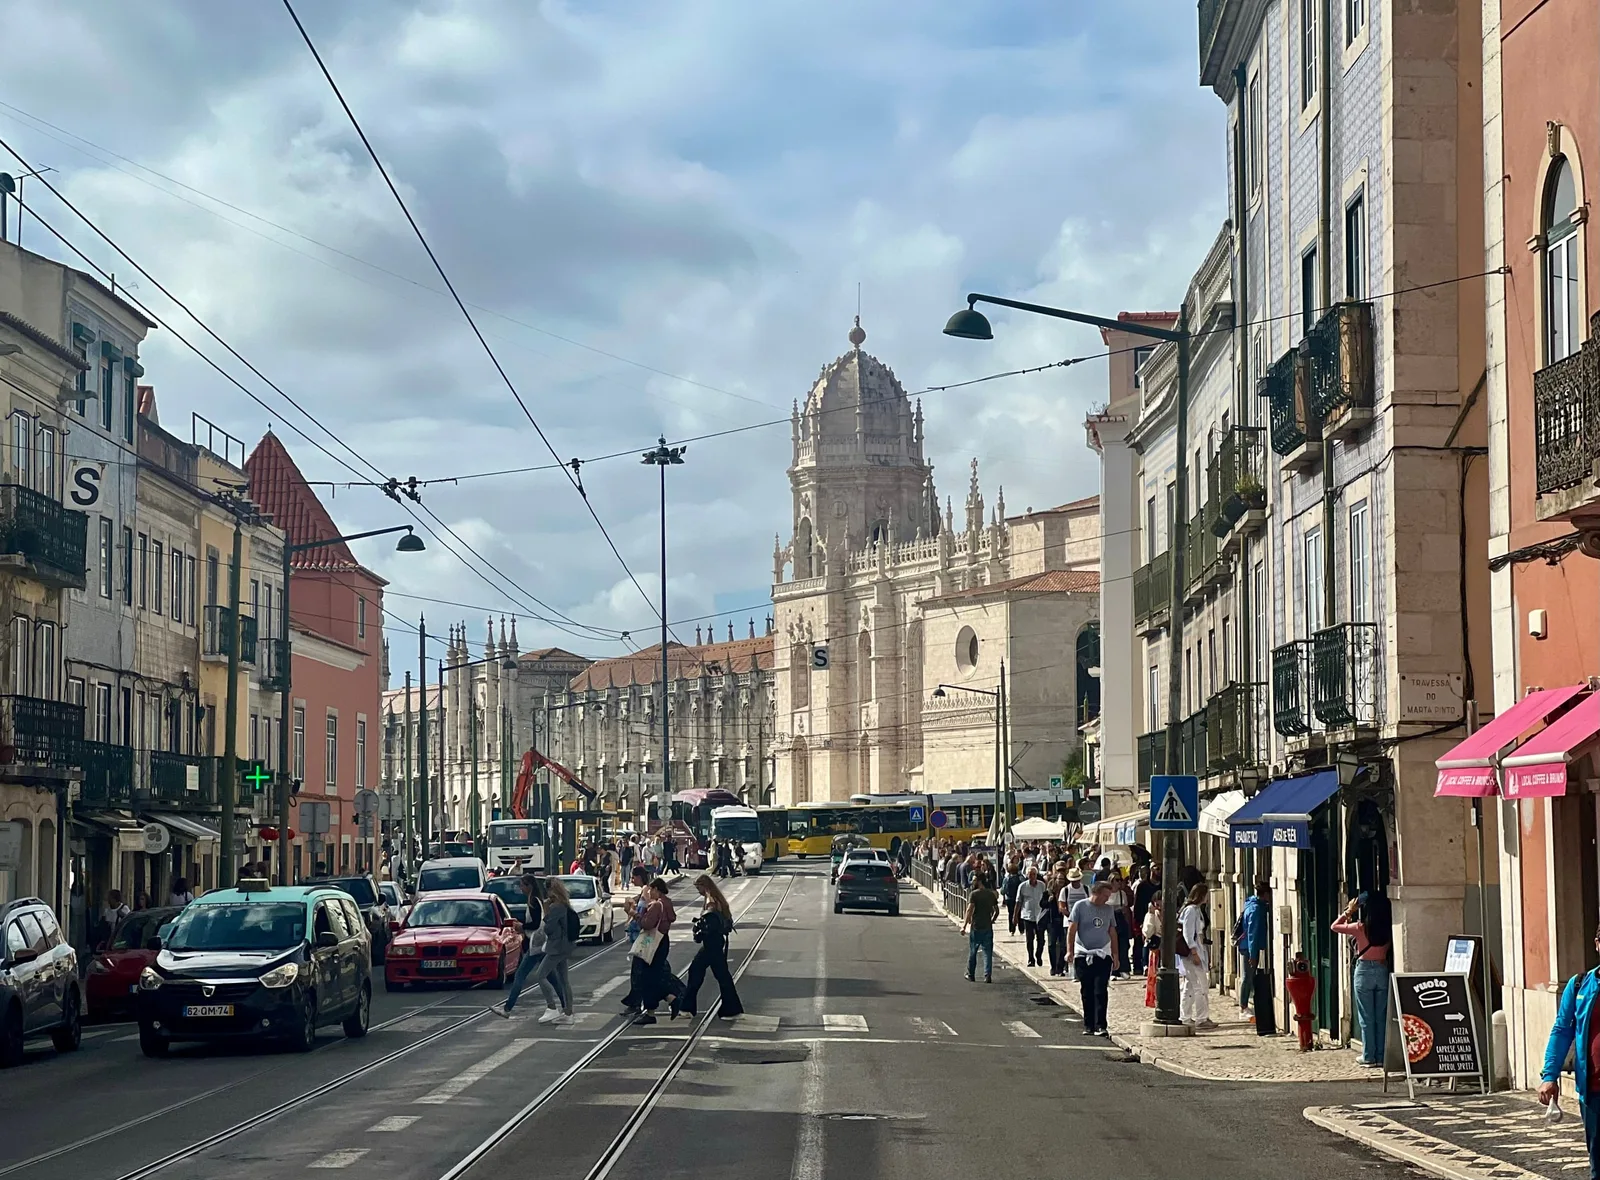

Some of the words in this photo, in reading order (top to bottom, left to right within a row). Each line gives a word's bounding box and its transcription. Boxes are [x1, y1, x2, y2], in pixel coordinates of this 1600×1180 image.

[71, 467, 101, 506] S
[814, 649, 828, 667] S
[1412, 679, 1450, 687] TRAVESSA
[1407, 706, 1432, 714] MARTA
[1413, 979, 1447, 993] ruoto
[1452, 1027, 1469, 1035] PIZZA
[1448, 1036, 1470, 1044] LASAGNA
[1457, 1045, 1471, 1053] SALAD
[1438, 1054, 1459, 1062] ITALIAN
[1457, 1062, 1474, 1071] SPRITZ
